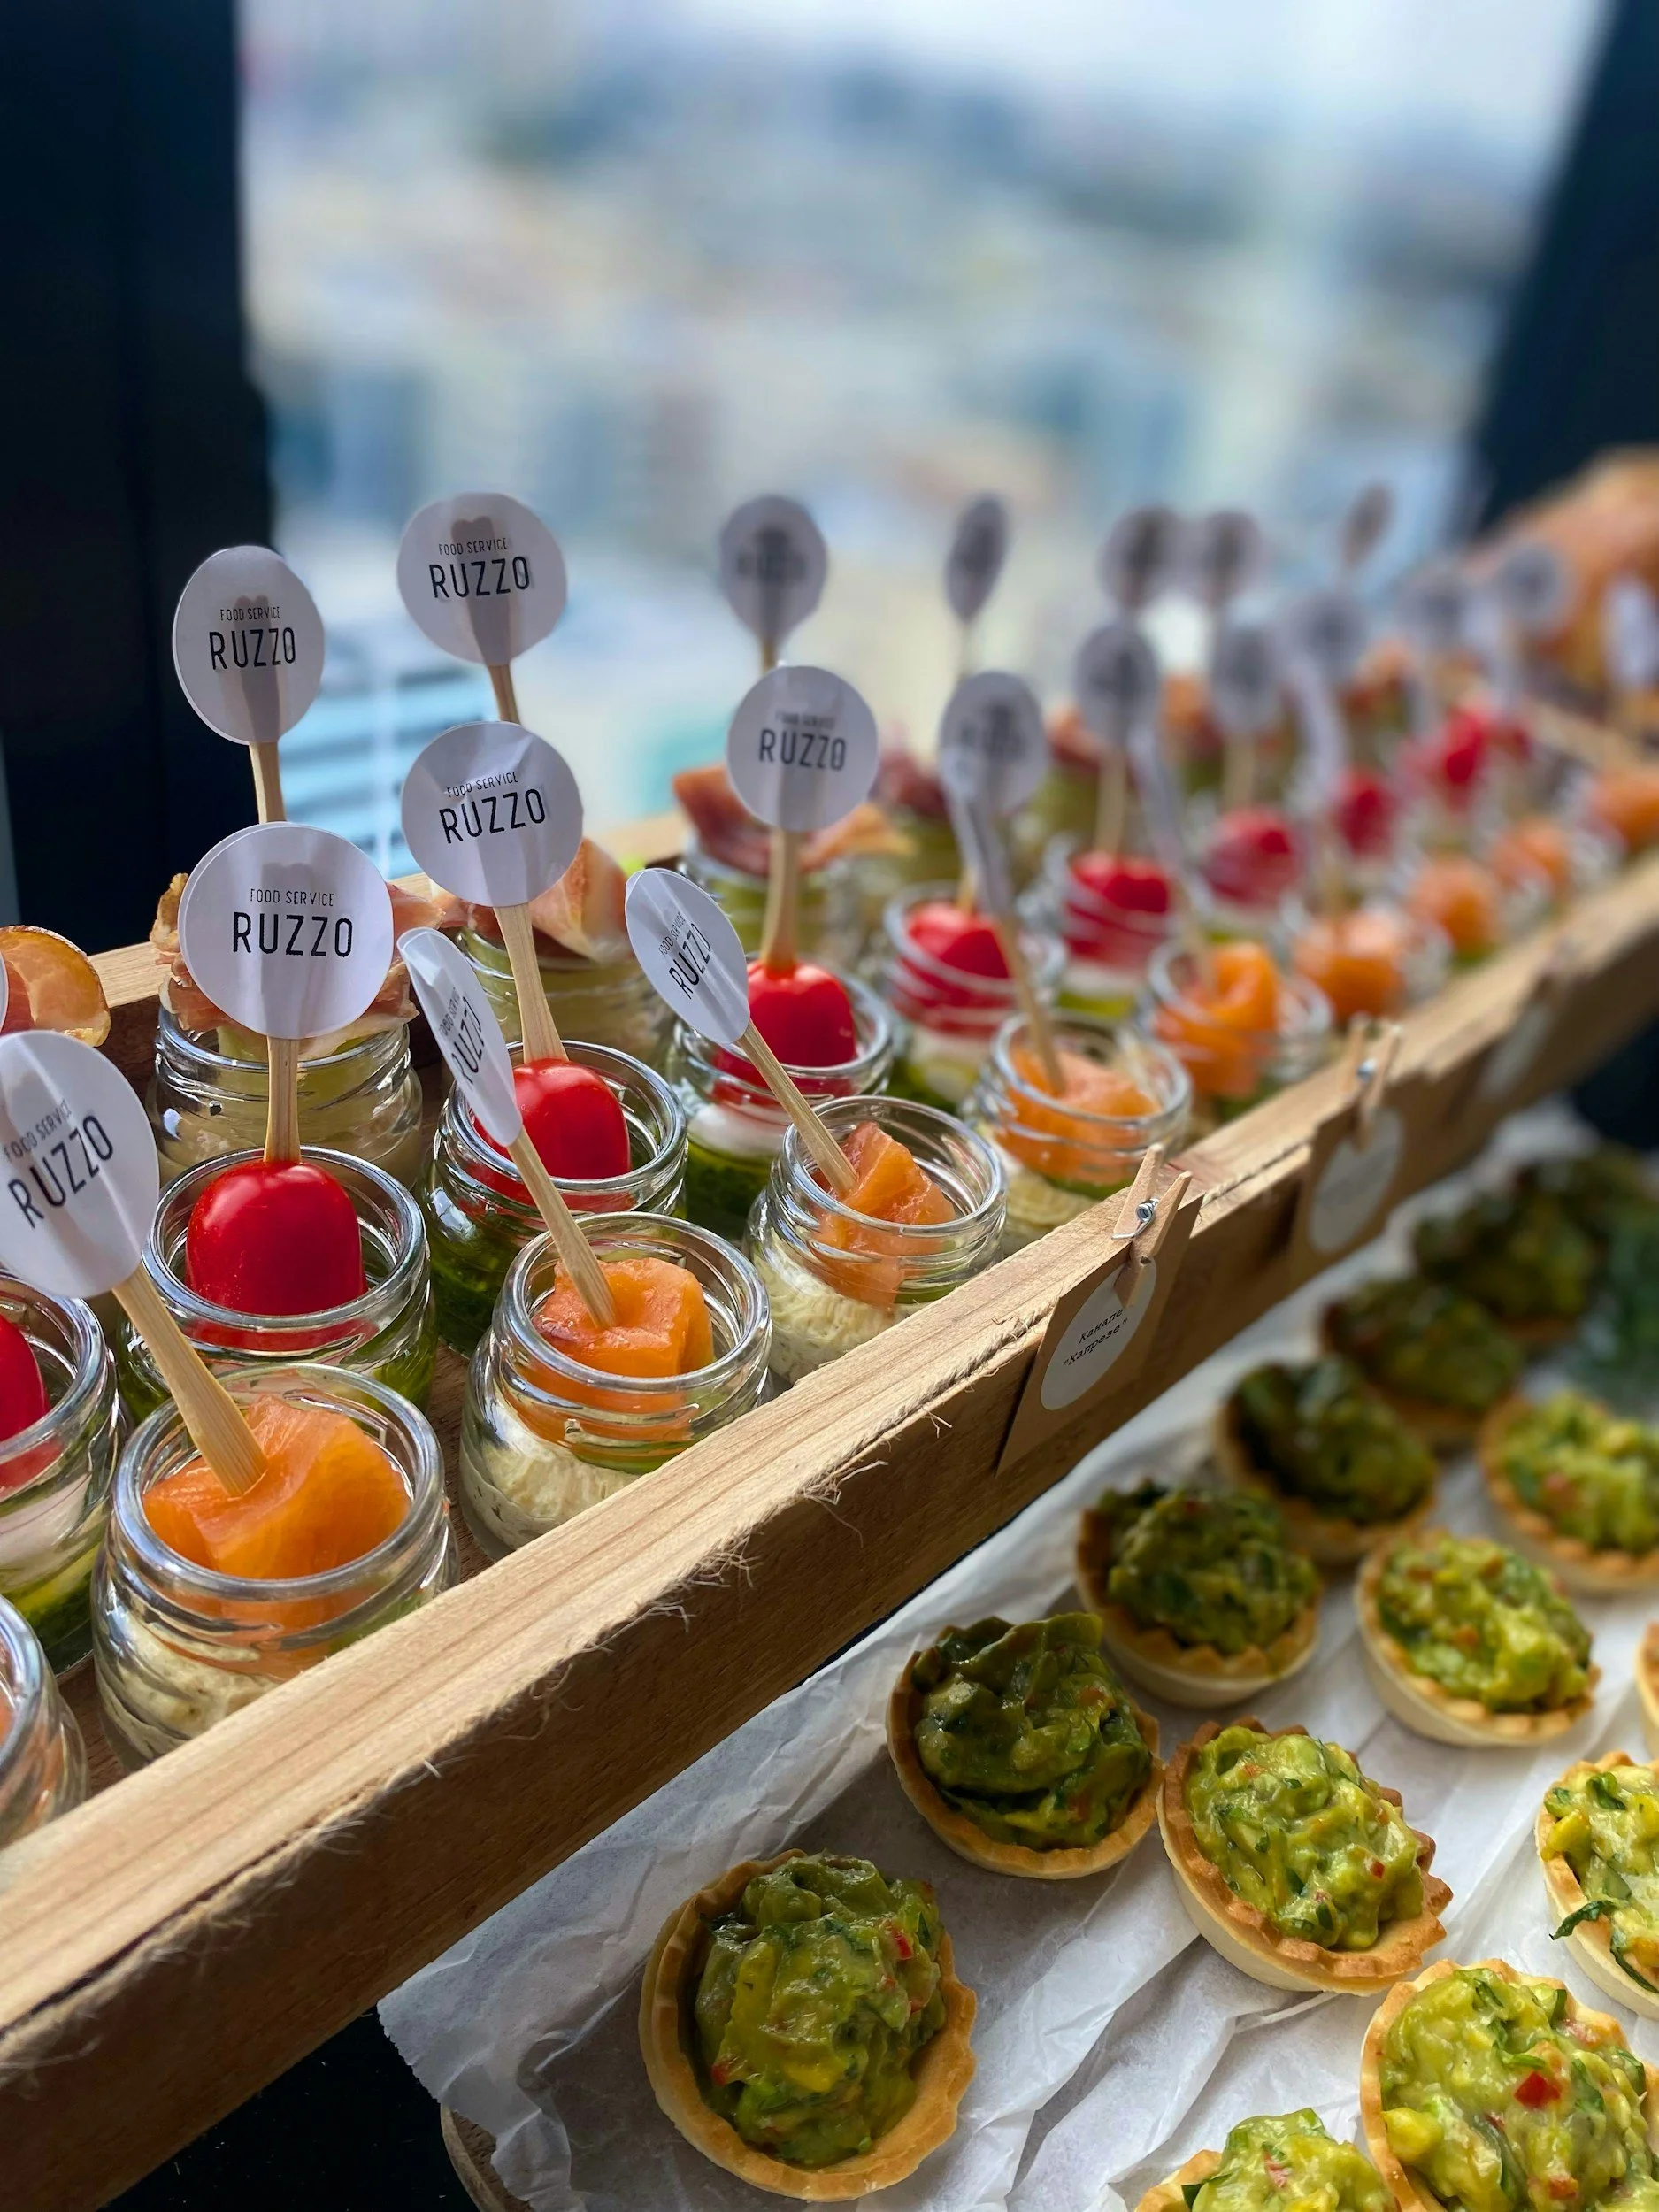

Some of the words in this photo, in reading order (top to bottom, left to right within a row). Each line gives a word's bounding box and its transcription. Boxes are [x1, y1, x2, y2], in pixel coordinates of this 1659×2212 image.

[438, 541, 464, 556] FOOD
[467, 537, 508, 554] SERVICE
[428, 556, 530, 598] RUZZO
[219, 608, 245, 621] FOOD
[248, 606, 280, 620] SERVICE
[209, 626, 296, 670] RUZZO
[759, 727, 847, 772] RUZZO
[446, 782, 473, 798] FOOD
[476, 771, 519, 791] SERVICE
[439, 788, 546, 844] RUZZO
[250, 888, 280, 903] FOOD
[285, 890, 334, 907] SERVICE
[233, 911, 353, 957] RUZZO
[658, 935, 674, 957] FOOD
[668, 923, 711, 1000] RUZZO
[8, 1115, 114, 1230] RUZZO
[1079, 1309, 1124, 1344] Канапе
